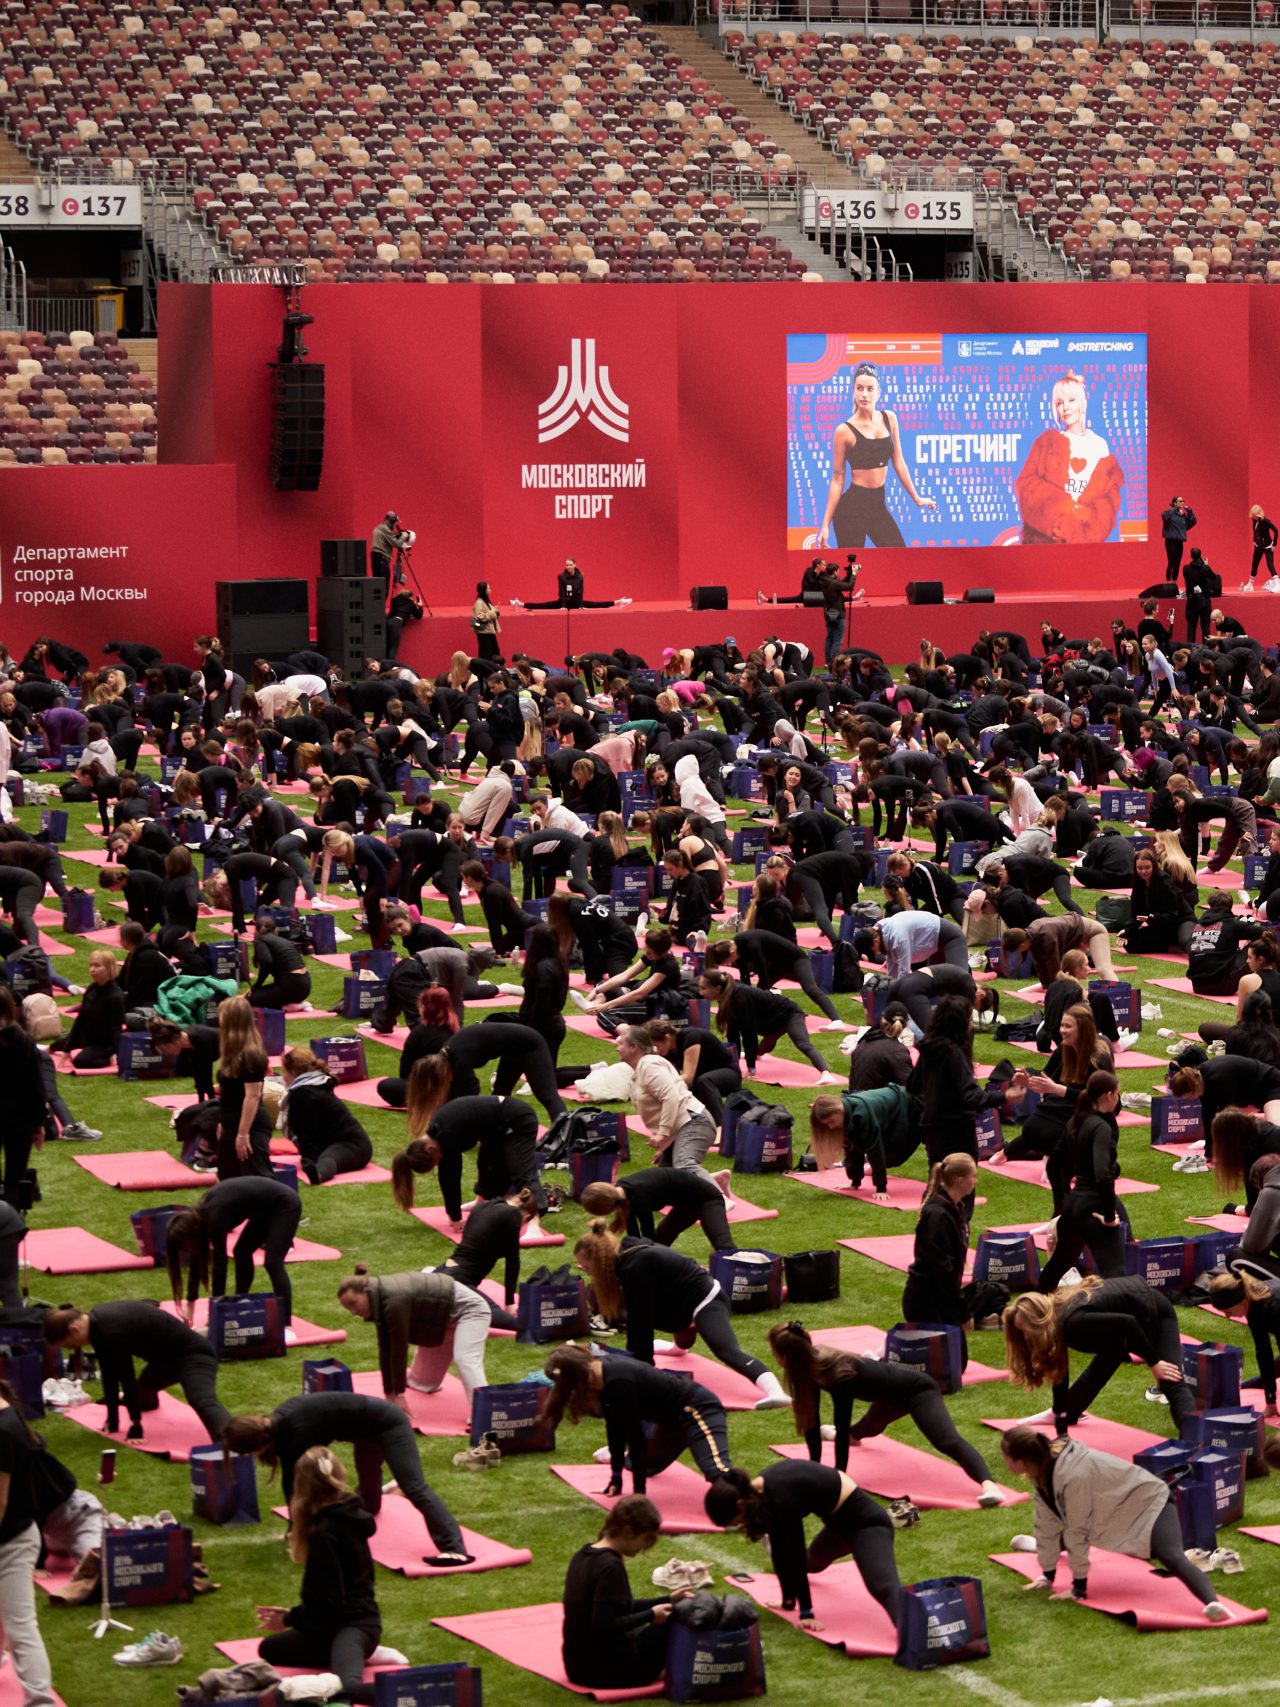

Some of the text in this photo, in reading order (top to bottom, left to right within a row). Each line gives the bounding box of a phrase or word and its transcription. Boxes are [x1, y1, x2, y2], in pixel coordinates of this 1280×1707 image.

[83, 196, 126, 216] 137
[836, 200, 876, 219] 136
[923, 202, 961, 221] 135
[954, 262, 969, 279] 135
[896, 393, 1031, 402] СПОРТ! ВСЕ НА СПОРТ!
[906, 385, 942, 393] СПОРТ!
[937, 403, 955, 411] ВСЕ
[964, 403, 976, 411] НА
[986, 402, 1027, 410] СПОРТ!
[916, 434, 1022, 464] СТРЕТЧИНГ
[521, 458, 646, 488] МОСКОВСКИЙ
[555, 495, 613, 519] СПОРТ
[967, 495, 1003, 503] СПОРТ!
[970, 504, 1007, 512] СПОРТ!
[972, 513, 1009, 522] СПОРТ!
[13, 546, 128, 563] Департамент
[14, 568, 74, 585] спорта
[15, 586, 148, 607] города Москвы
